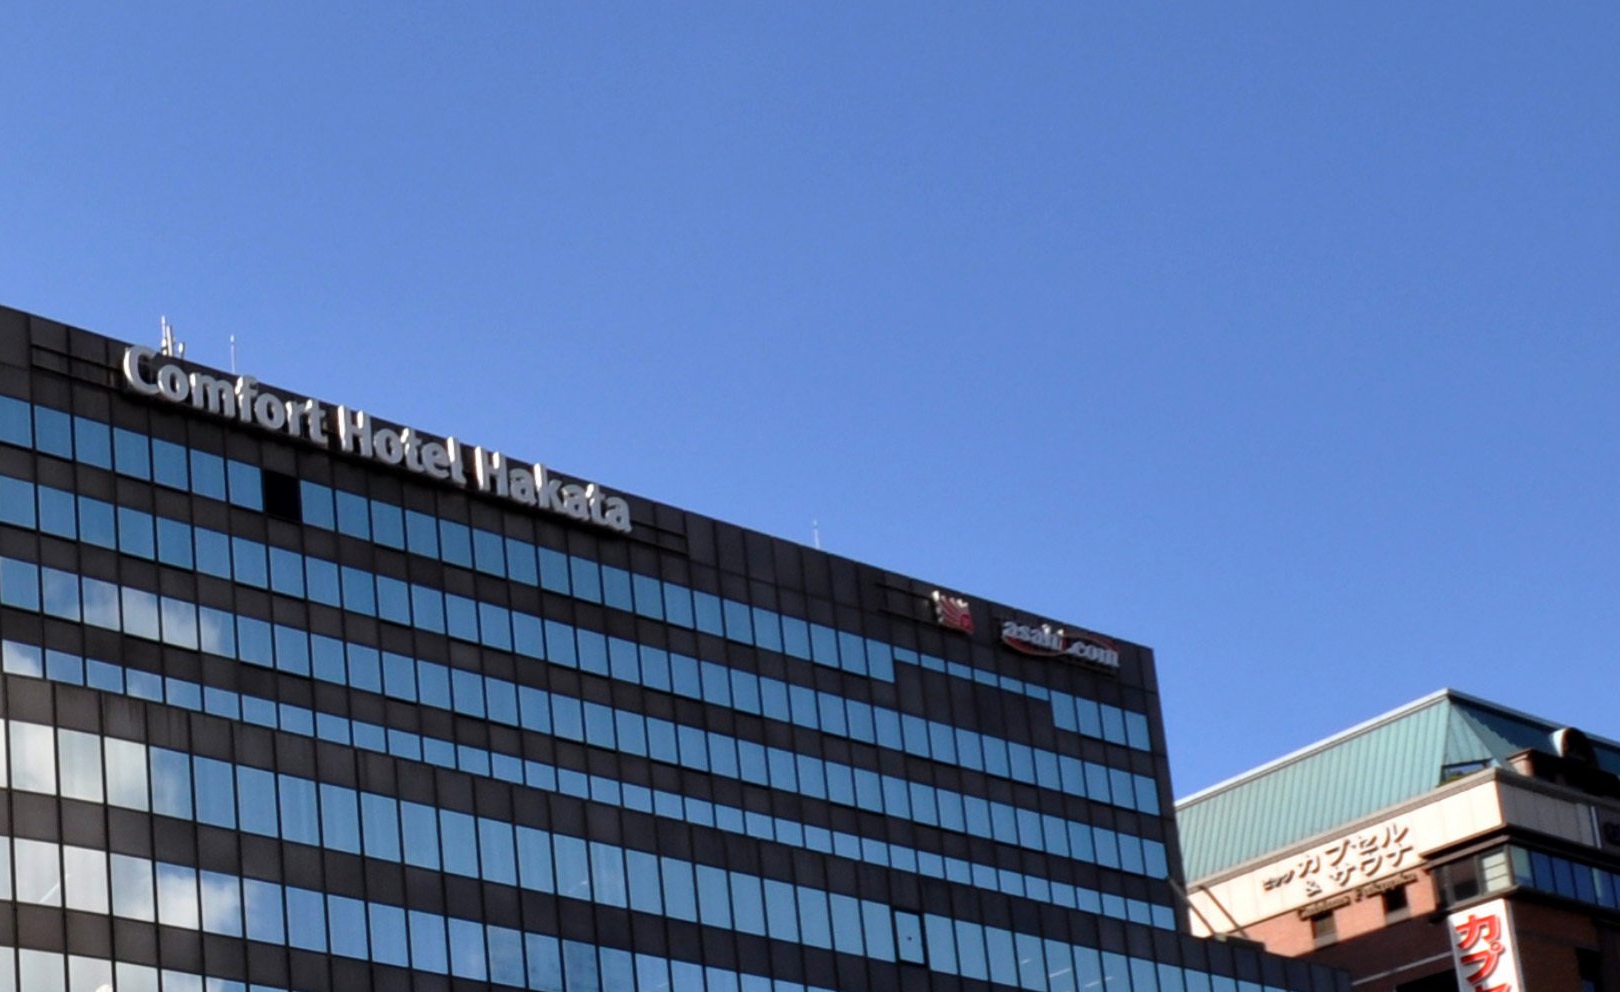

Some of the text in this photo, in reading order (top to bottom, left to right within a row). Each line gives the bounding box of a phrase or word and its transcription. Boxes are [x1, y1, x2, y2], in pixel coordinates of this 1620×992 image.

[123, 344, 633, 533] Comfort Hotel Hakata
